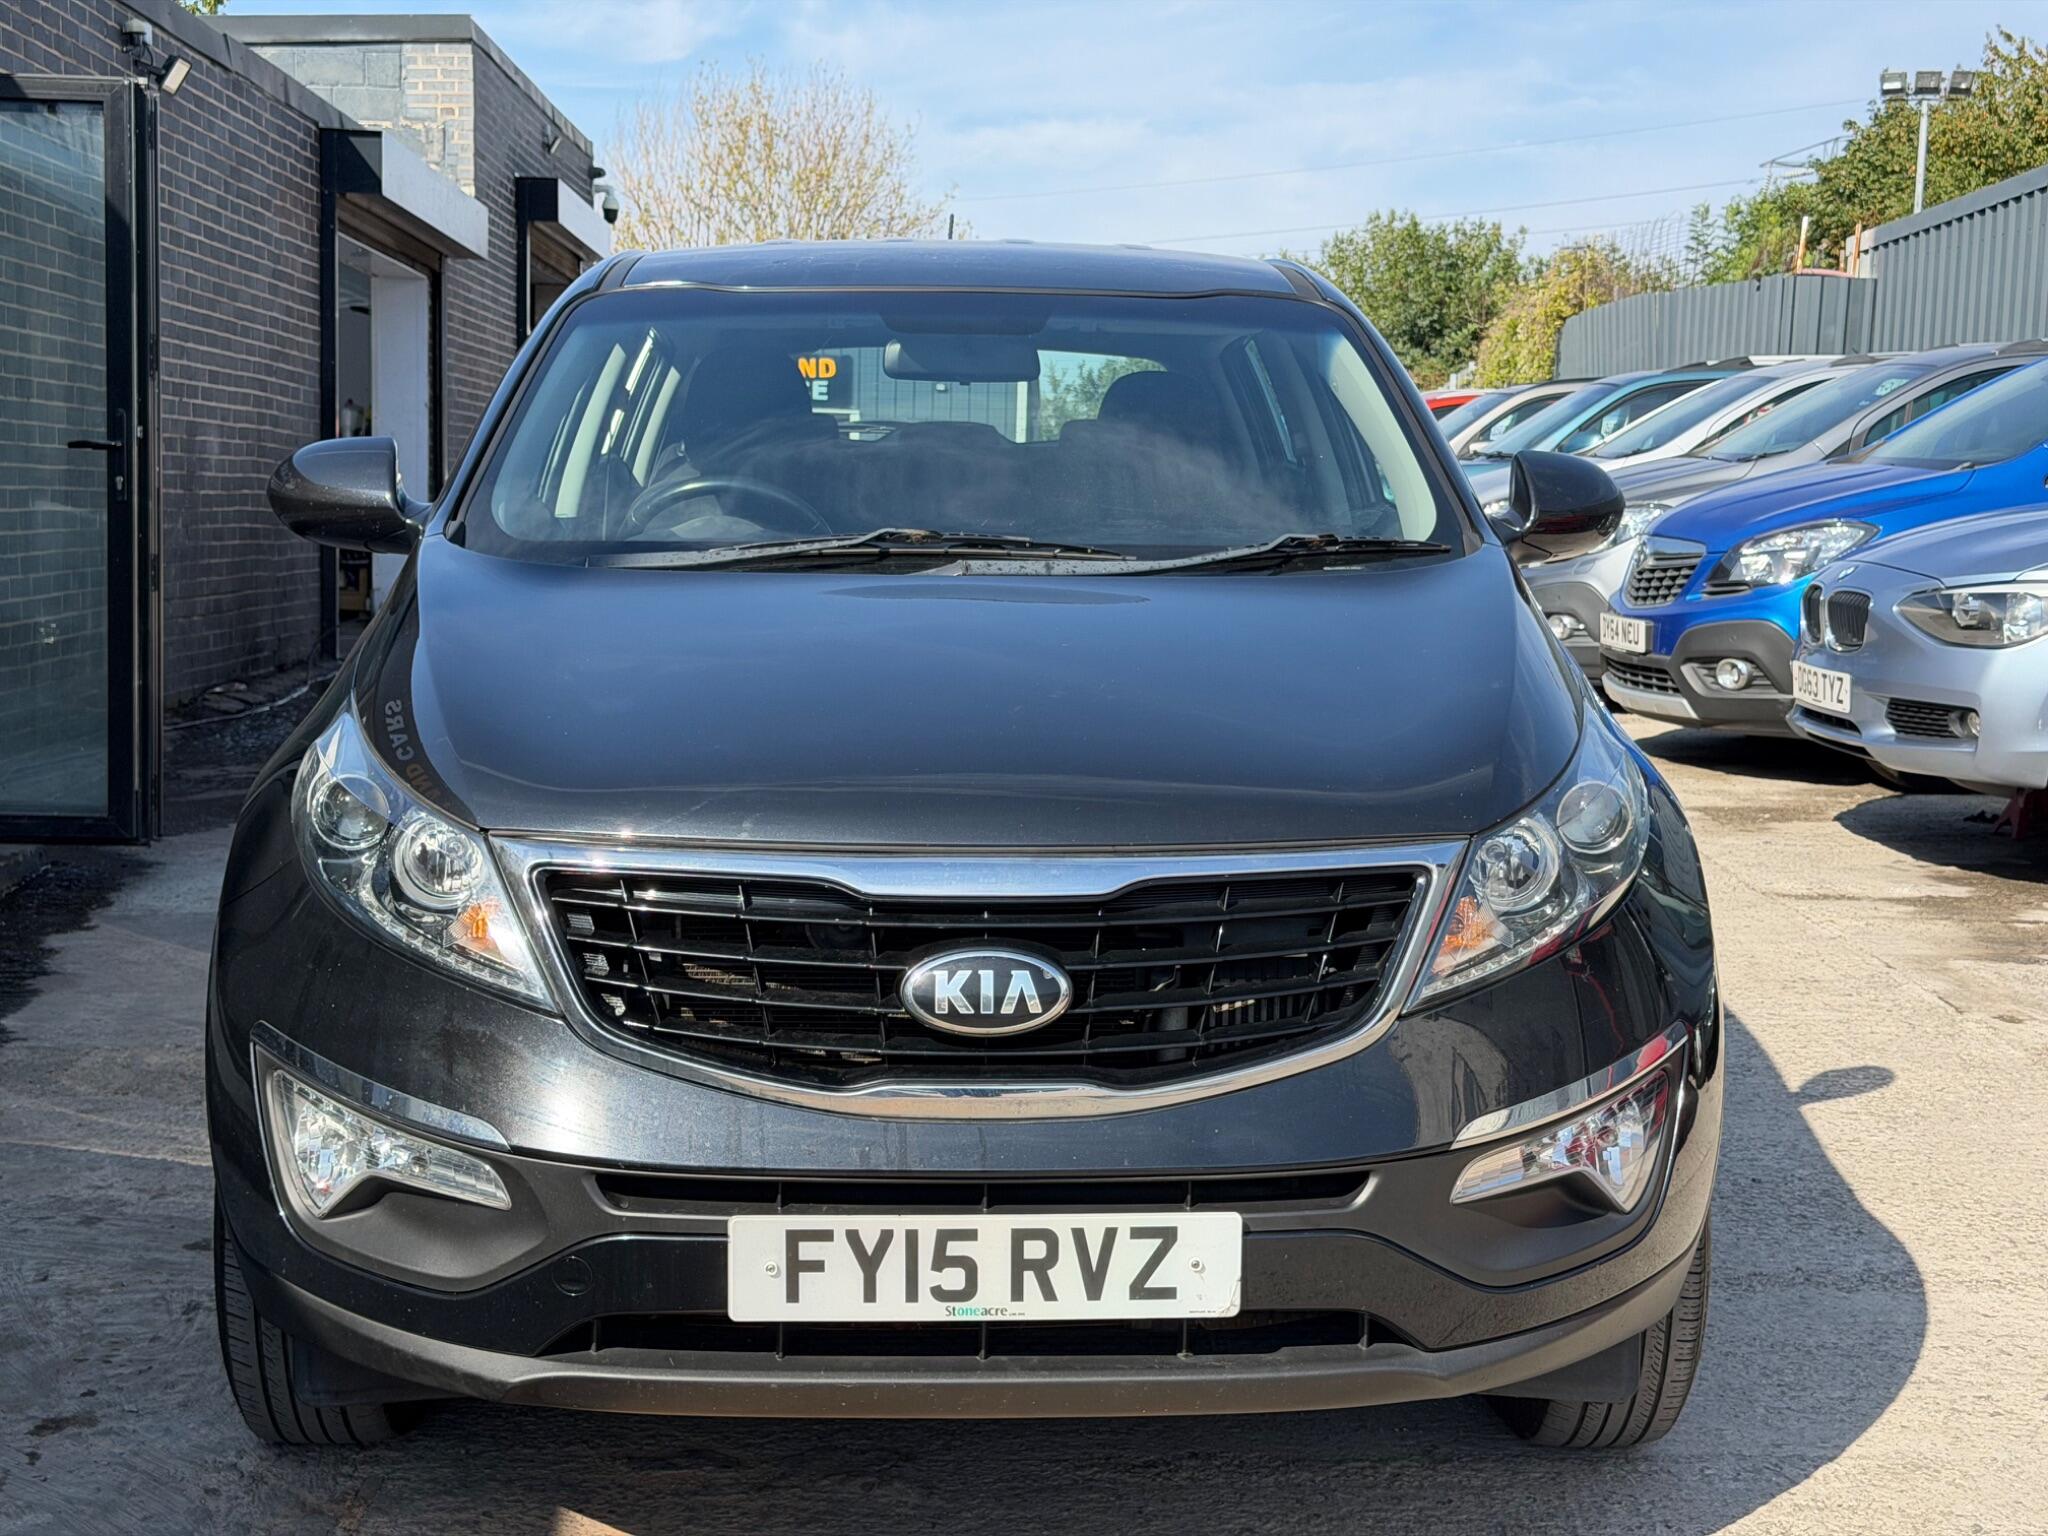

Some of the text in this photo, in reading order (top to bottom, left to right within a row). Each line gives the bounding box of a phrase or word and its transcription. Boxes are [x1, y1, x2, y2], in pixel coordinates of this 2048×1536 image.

[805, 380, 829, 401] E
[1821, 672, 1844, 704] TYZ
[934, 969, 1043, 1015] KIA
[785, 1226, 1178, 1304] FY15 RVZ
[945, 1305, 1008, 1317] Stoneacre
